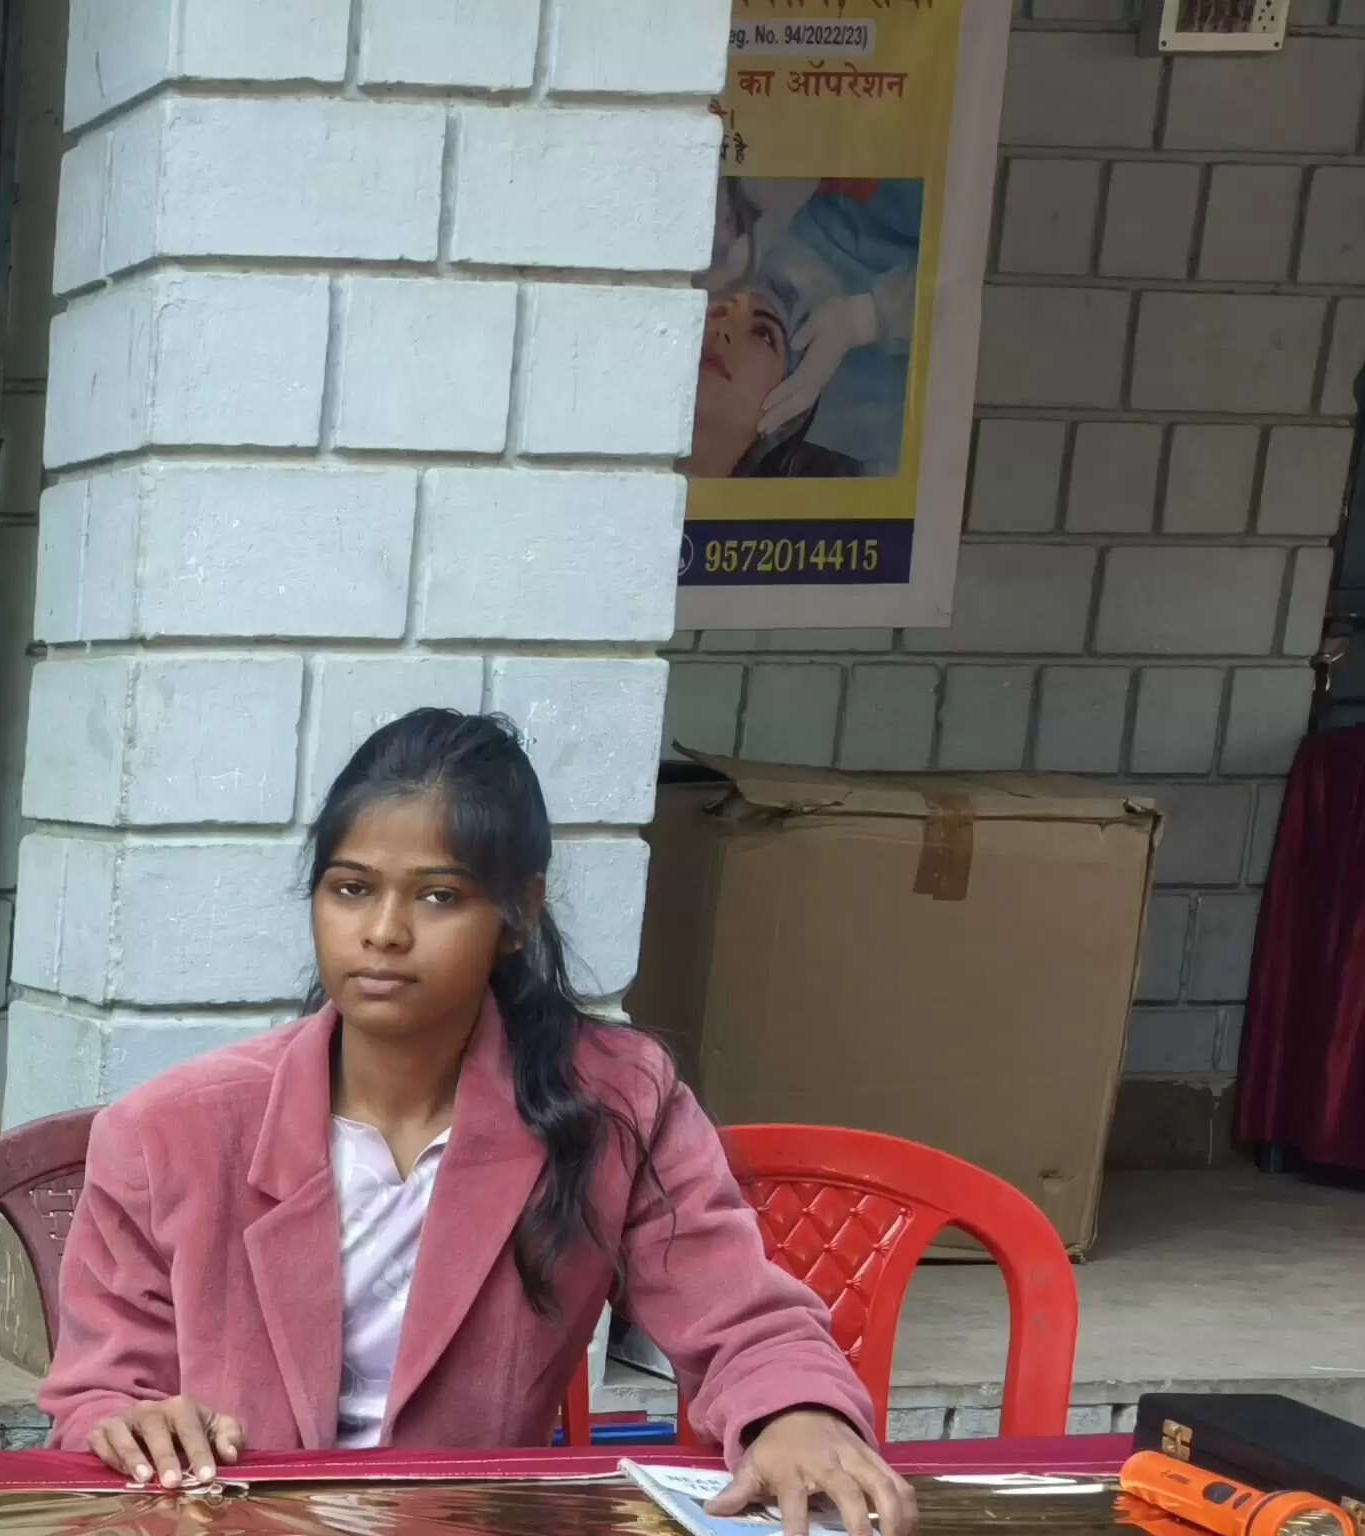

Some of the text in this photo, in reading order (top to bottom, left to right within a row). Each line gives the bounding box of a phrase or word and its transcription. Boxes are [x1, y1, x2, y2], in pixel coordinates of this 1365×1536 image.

[755, 25, 779, 44] No.
[785, 26, 868, 49] 94/2022/23)
[737, 60, 908, 98] का ऑपरेशन
[704, 537, 878, 572] 9572014415
